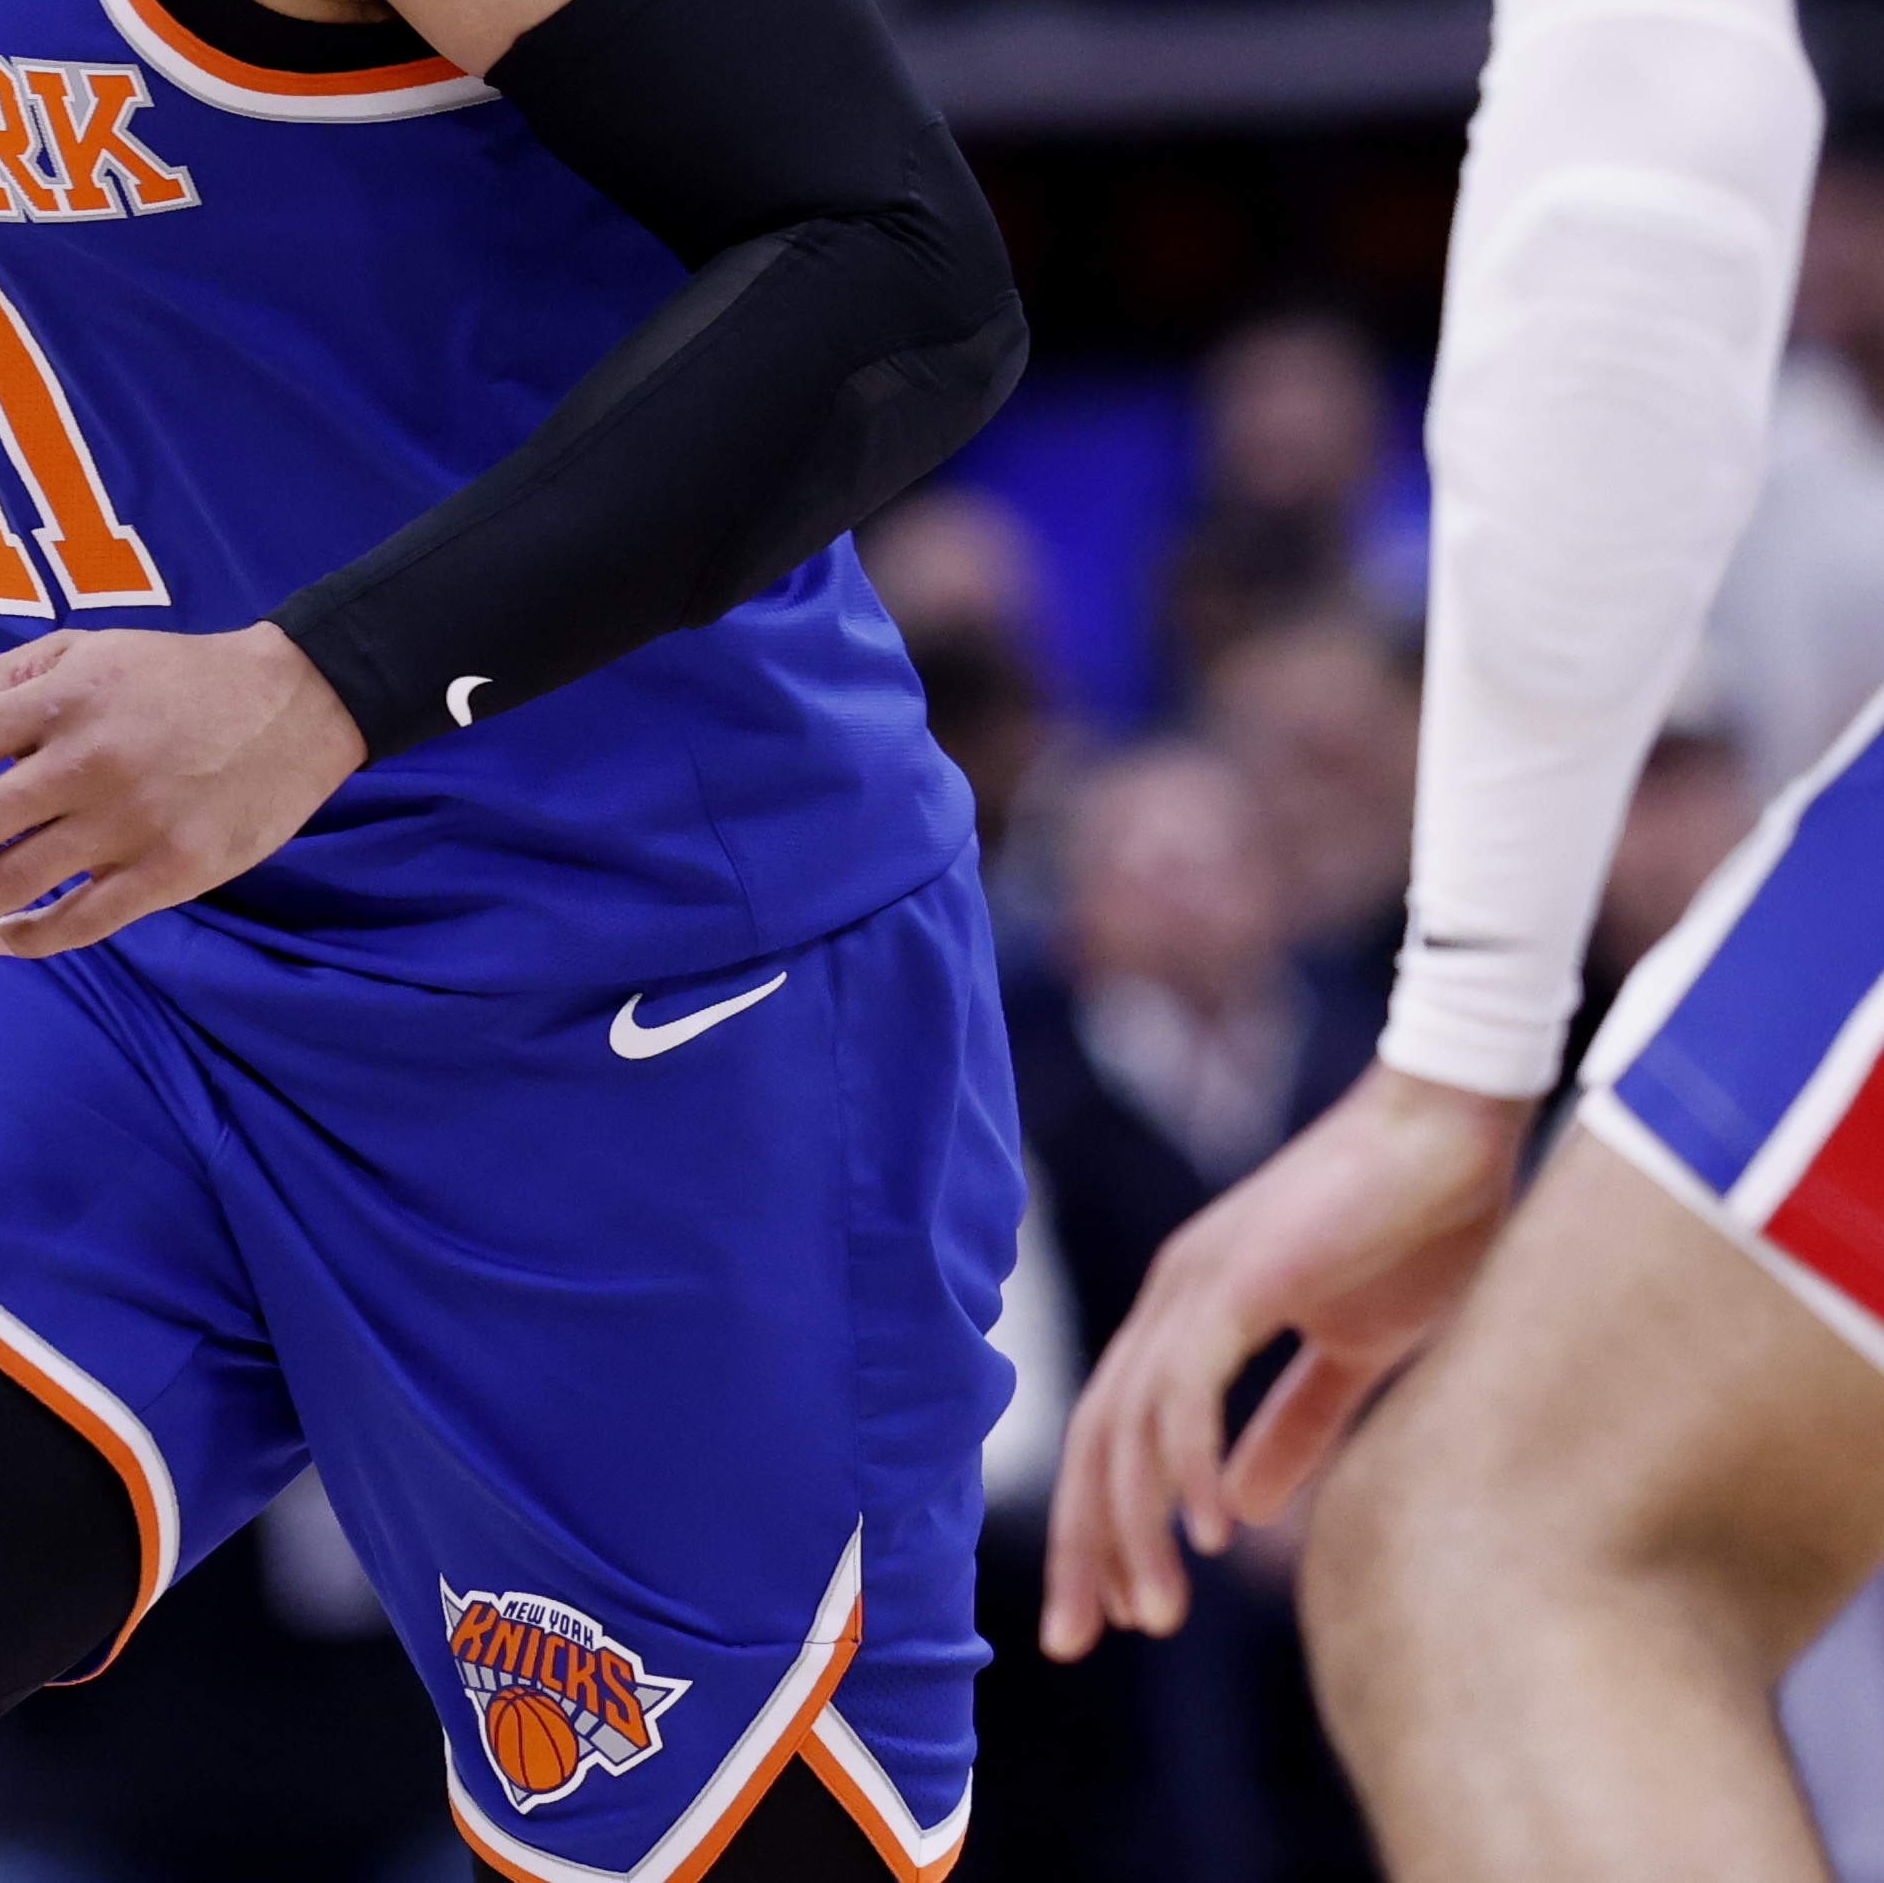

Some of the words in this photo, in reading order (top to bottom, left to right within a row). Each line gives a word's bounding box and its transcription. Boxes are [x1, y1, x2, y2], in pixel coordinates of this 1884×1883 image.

[449, 1599, 653, 1749] KNICKS
[502, 1600, 547, 1625] NEW
[548, 1610, 595, 1650] YORK
